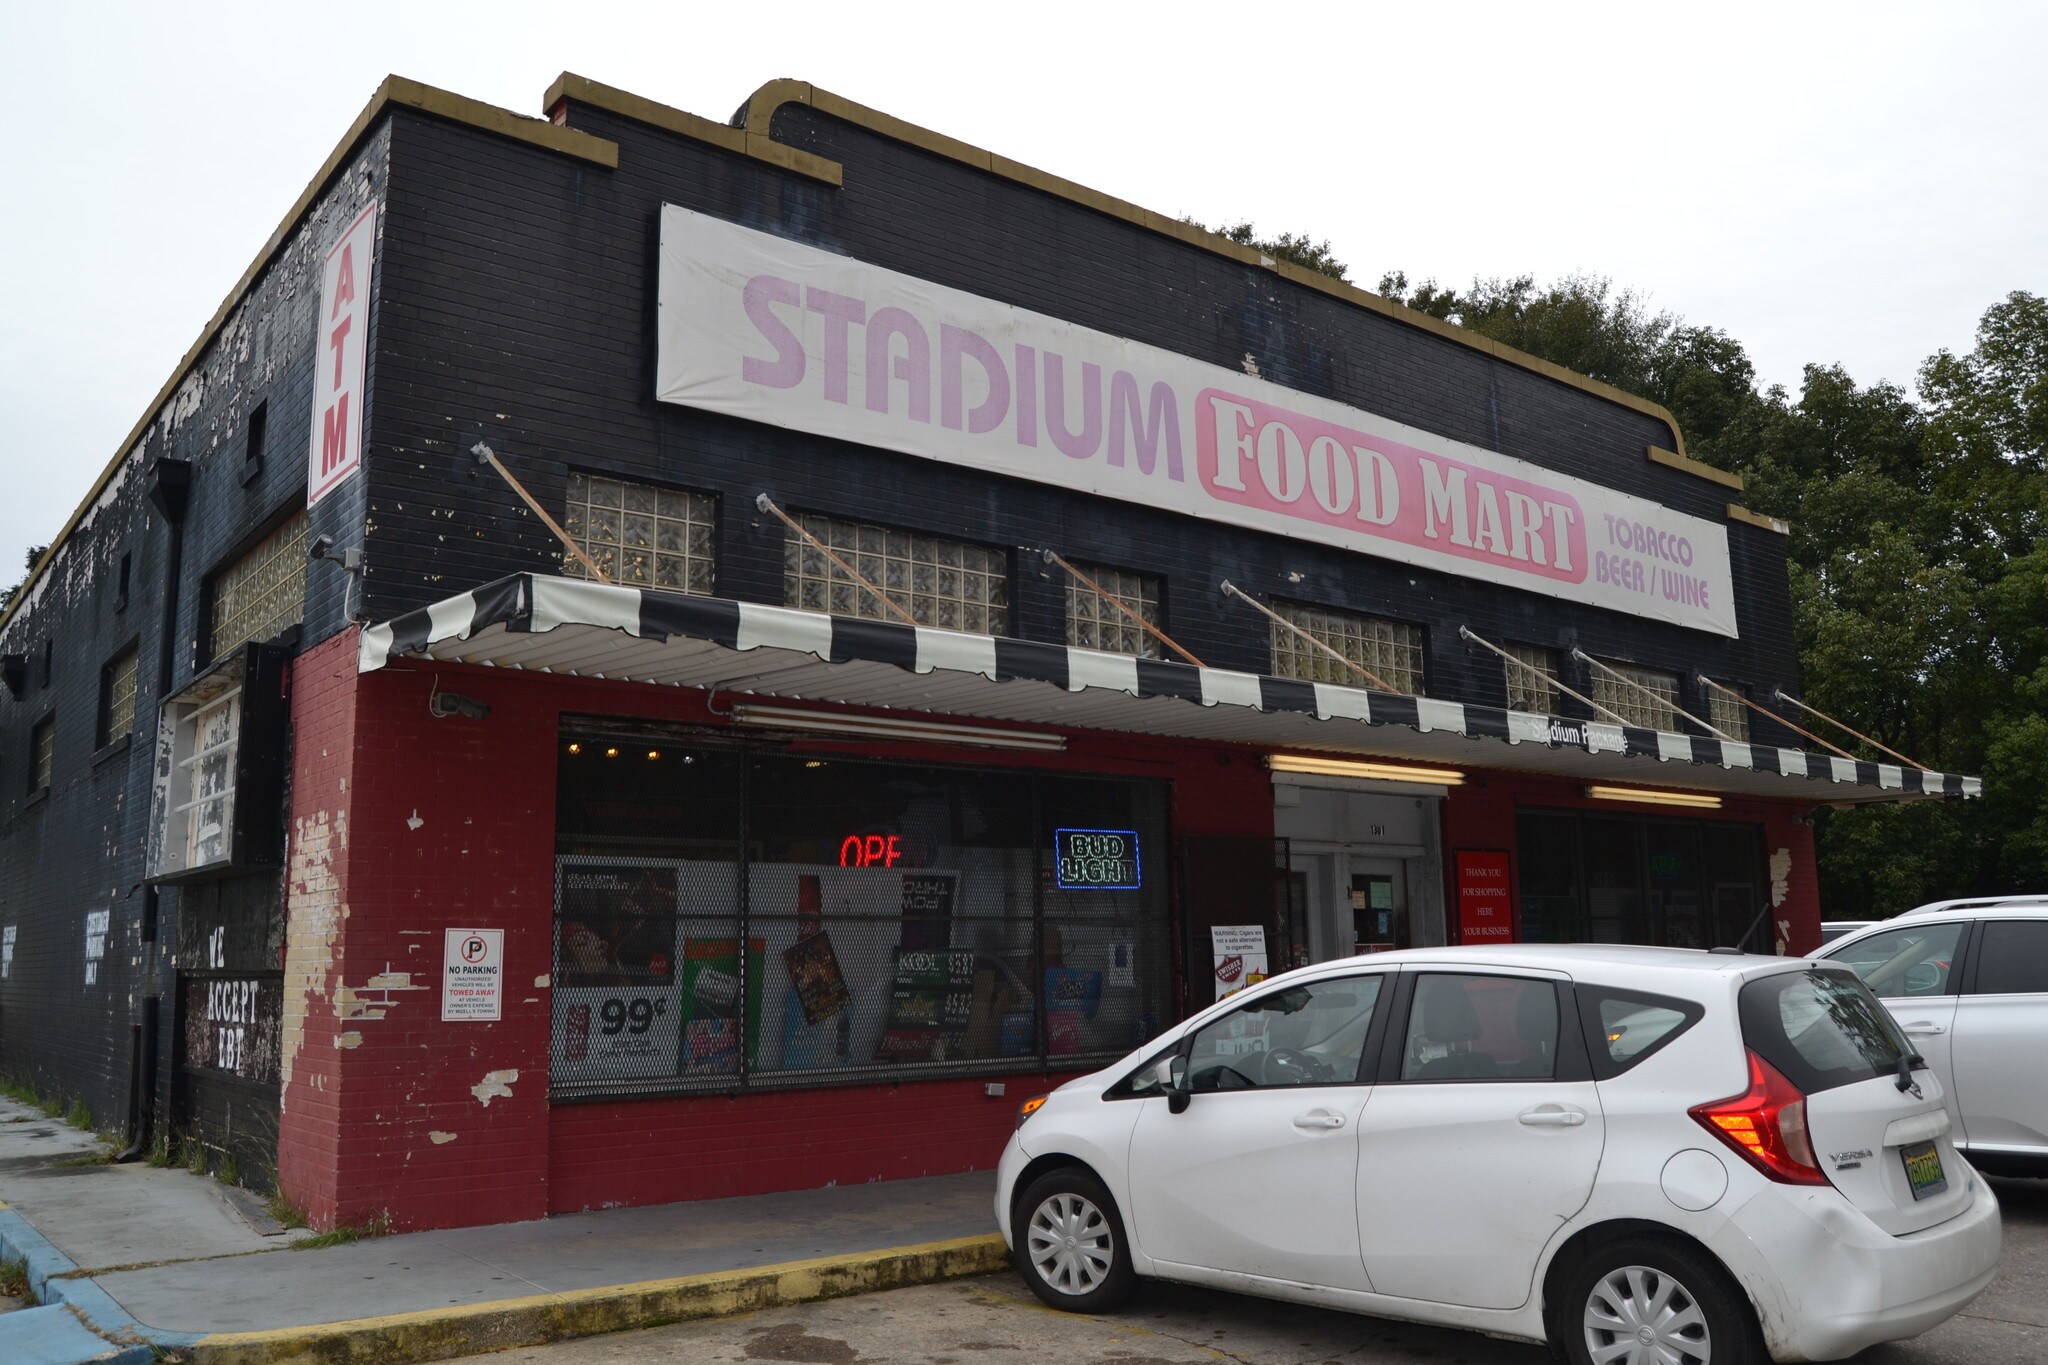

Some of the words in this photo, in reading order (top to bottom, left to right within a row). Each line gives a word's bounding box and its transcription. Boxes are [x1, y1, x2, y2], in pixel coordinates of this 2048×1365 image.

[321, 242, 354, 478] ATM
[742, 275, 1184, 483] STADIUM
[1210, 396, 1400, 526] FOOD
[1418, 457, 1575, 573] MART
[1604, 513, 1693, 568] TOBACCO
[1595, 550, 1645, 593] BEER
[1661, 568, 1710, 610] WINE
[1070, 834, 1124, 858] BUD
[1061, 858, 1136, 882] LIGHT
[1465, 868, 1487, 877] THANK
[1488, 868, 1501, 877] YOU
[1462, 888, 1475, 896] FOR
[1475, 888, 1506, 897] SHOPPING
[1477, 907, 1494, 916] HERE
[1464, 927, 1481, 936] YOUR
[1481, 927, 1510, 936] BUSINESS
[209, 926, 225, 968] WE
[448, 966, 461, 975] NO
[462, 966, 498, 975] PARKING
[1217, 958, 1242, 977] SWISHER
[208, 981, 259, 1024] ACCEPT
[218, 1027, 245, 1070] EBT
[1828, 1149, 1873, 1162] VERSA
